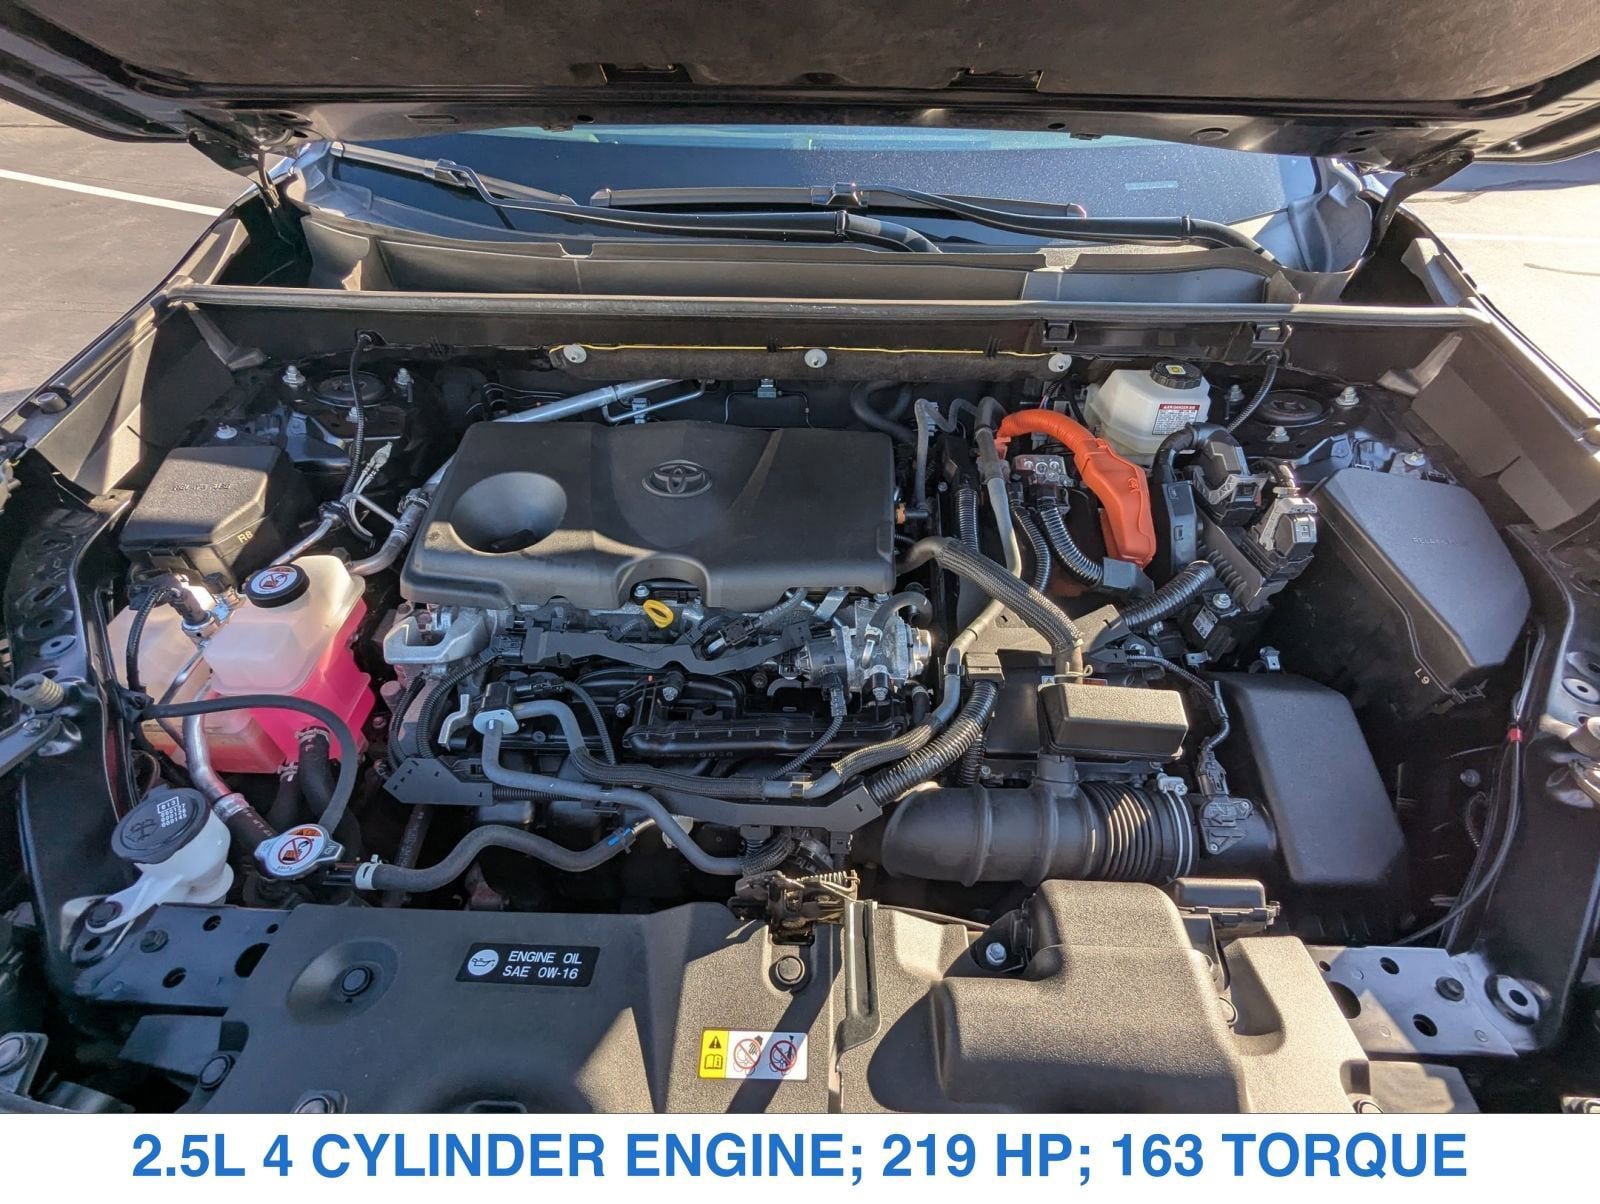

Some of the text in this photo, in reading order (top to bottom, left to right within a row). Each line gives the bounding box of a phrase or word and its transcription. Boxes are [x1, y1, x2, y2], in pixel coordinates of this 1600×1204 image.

[507, 950, 583, 965] ENGINE OIL
[502, 965, 579, 980] SAE 0W-16
